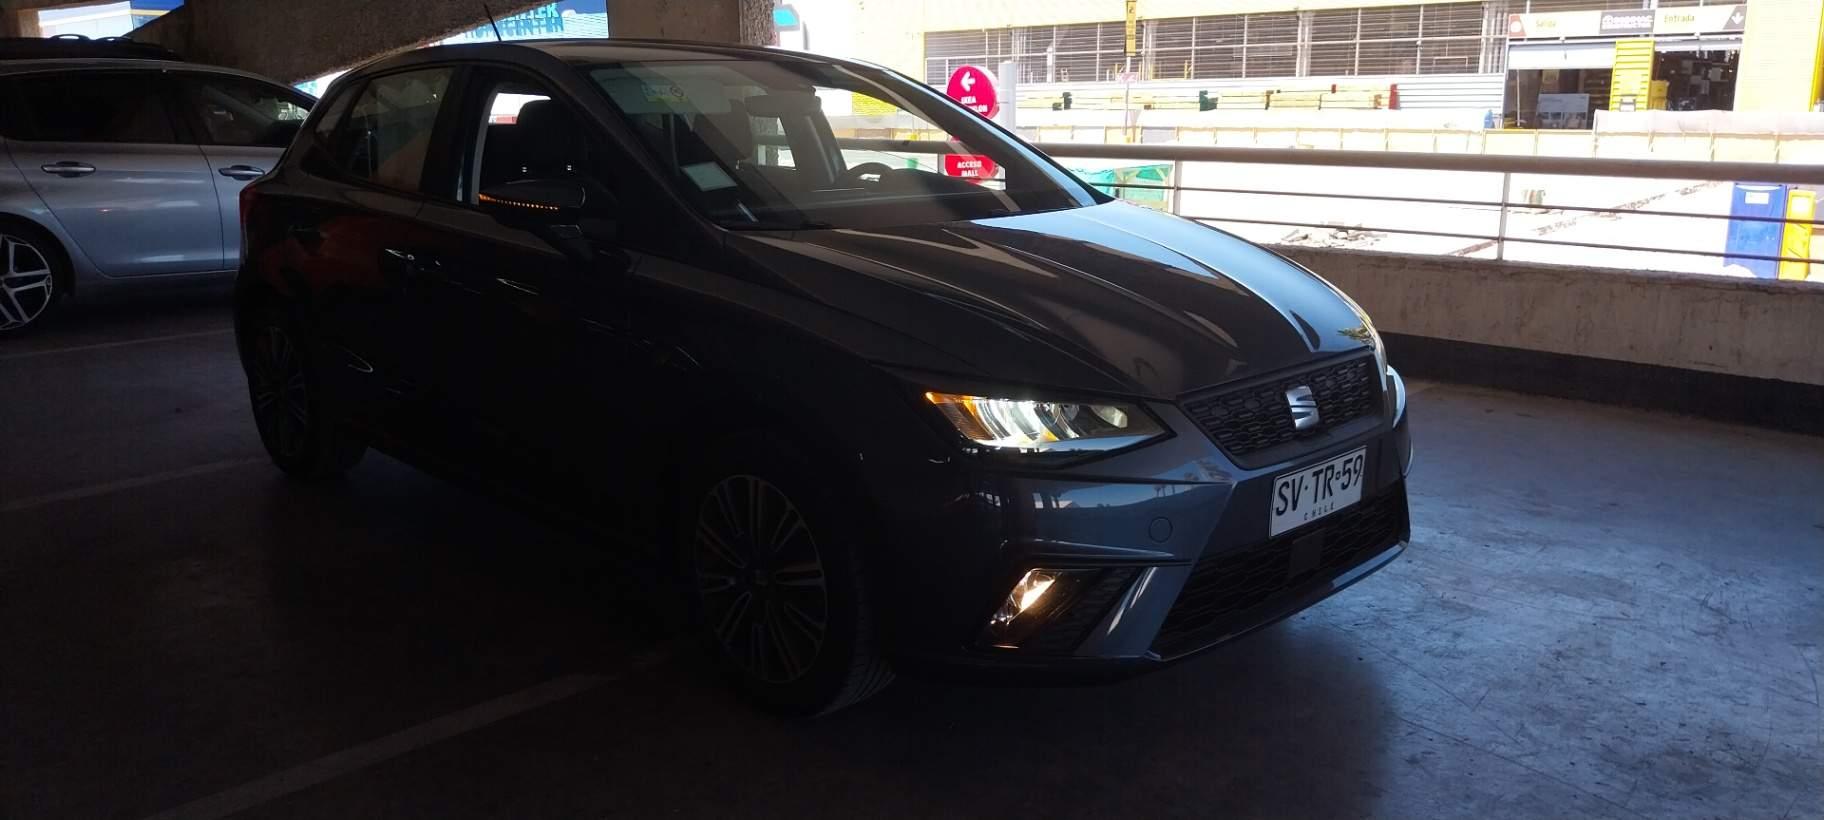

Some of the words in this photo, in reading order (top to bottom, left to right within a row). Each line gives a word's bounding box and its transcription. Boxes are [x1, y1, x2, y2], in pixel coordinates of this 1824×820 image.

[1663, 14, 1695, 24] Entrada
[961, 96, 977, 104] IKEA
[957, 160, 982, 169] ACCESO
[961, 169, 979, 177] MALL
[1304, 502, 1335, 521] CHILE
